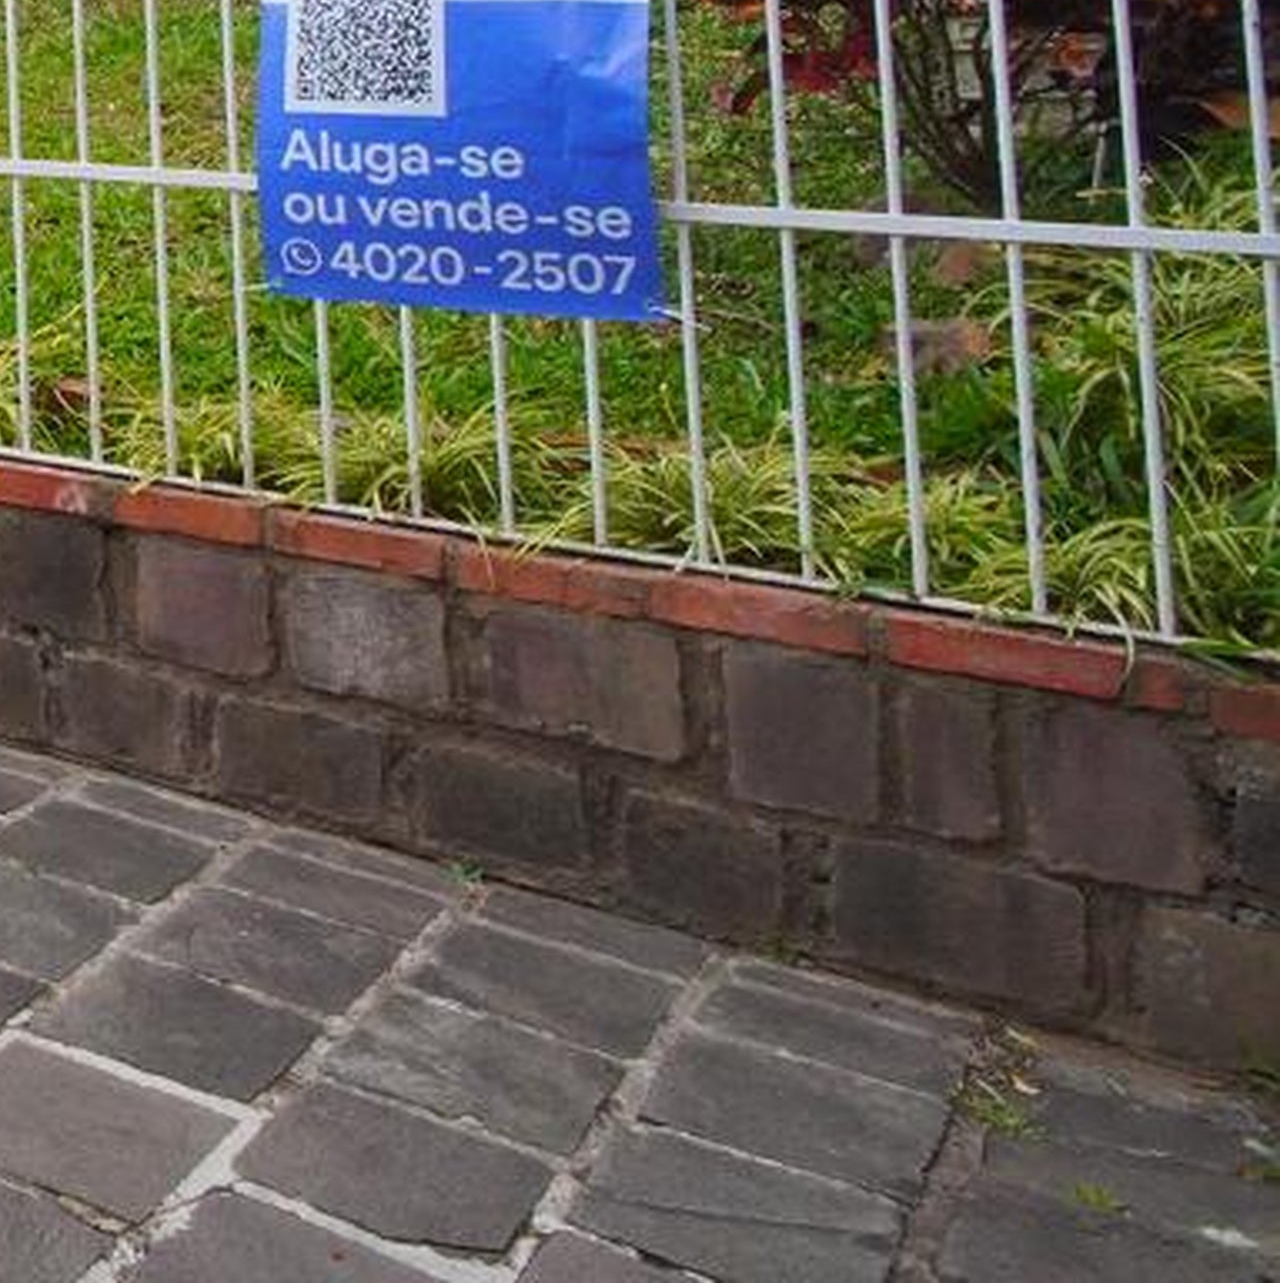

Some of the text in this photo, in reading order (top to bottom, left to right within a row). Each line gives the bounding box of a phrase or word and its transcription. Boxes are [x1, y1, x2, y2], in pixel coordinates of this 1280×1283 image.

[280, 129, 526, 184] Aluga-se
[284, 192, 634, 237] ou vende-se
